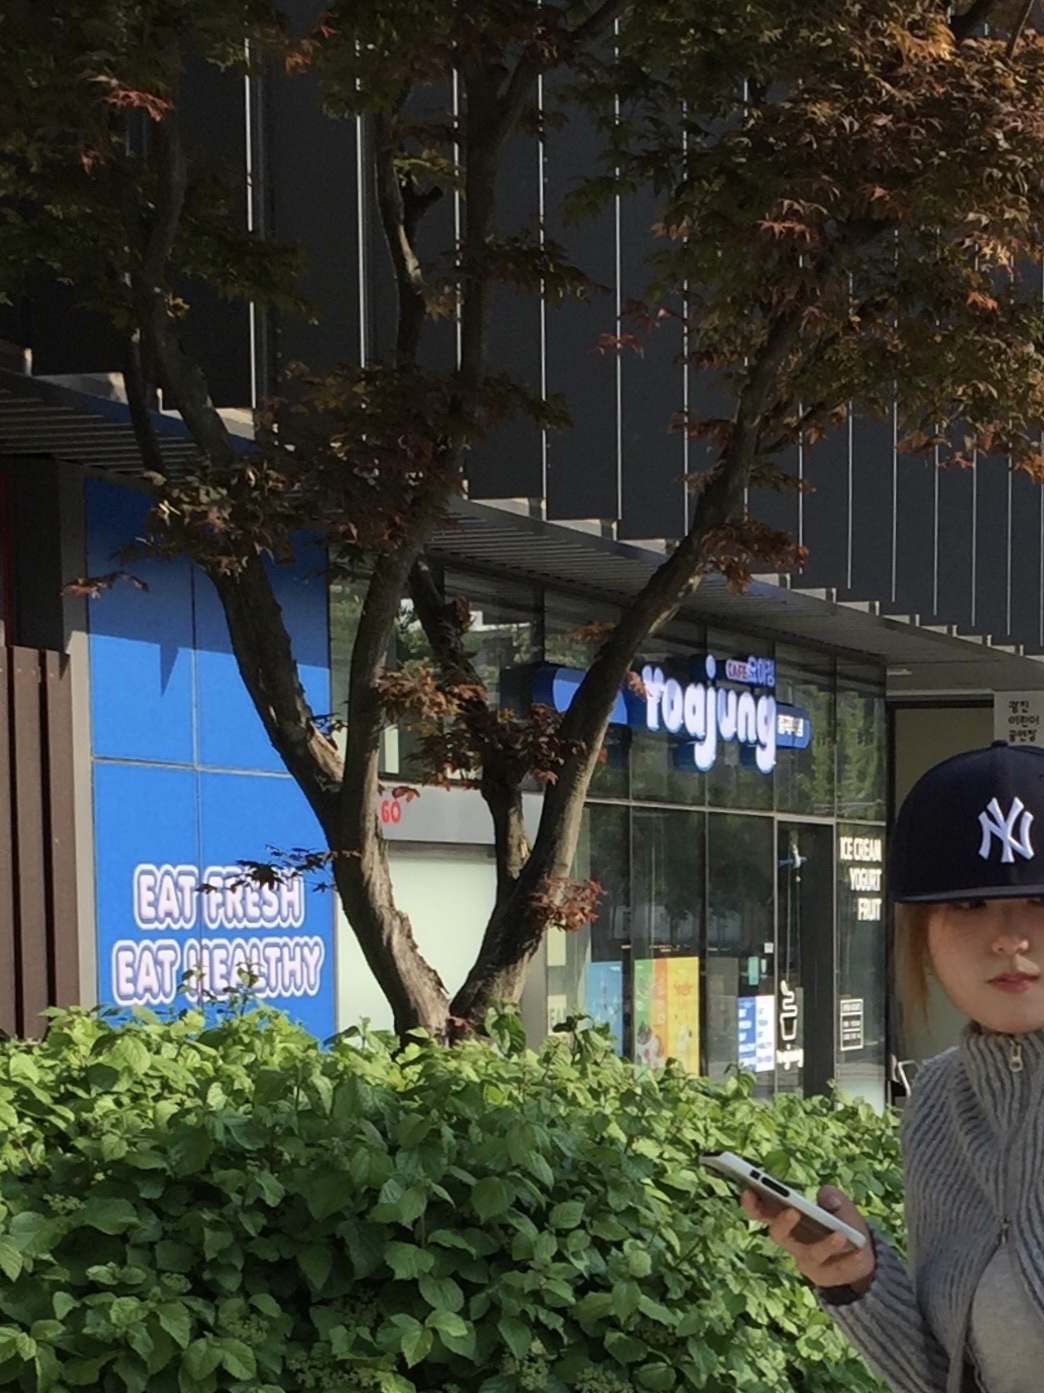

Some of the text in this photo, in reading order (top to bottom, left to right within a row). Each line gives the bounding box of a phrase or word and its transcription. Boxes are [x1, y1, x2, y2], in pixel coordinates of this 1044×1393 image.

[726, 660, 748, 681] CAFE
[641, 654, 776, 774] Yoajung
[840, 836, 882, 862] ICE CREAM
[978, 796, 1035, 863] NY
[134, 864, 305, 929] EAT FRESH
[849, 867, 882, 891] YOGURT
[857, 897, 882, 921] FRUIT
[112, 936, 325, 1005] EAT HEALTHY
